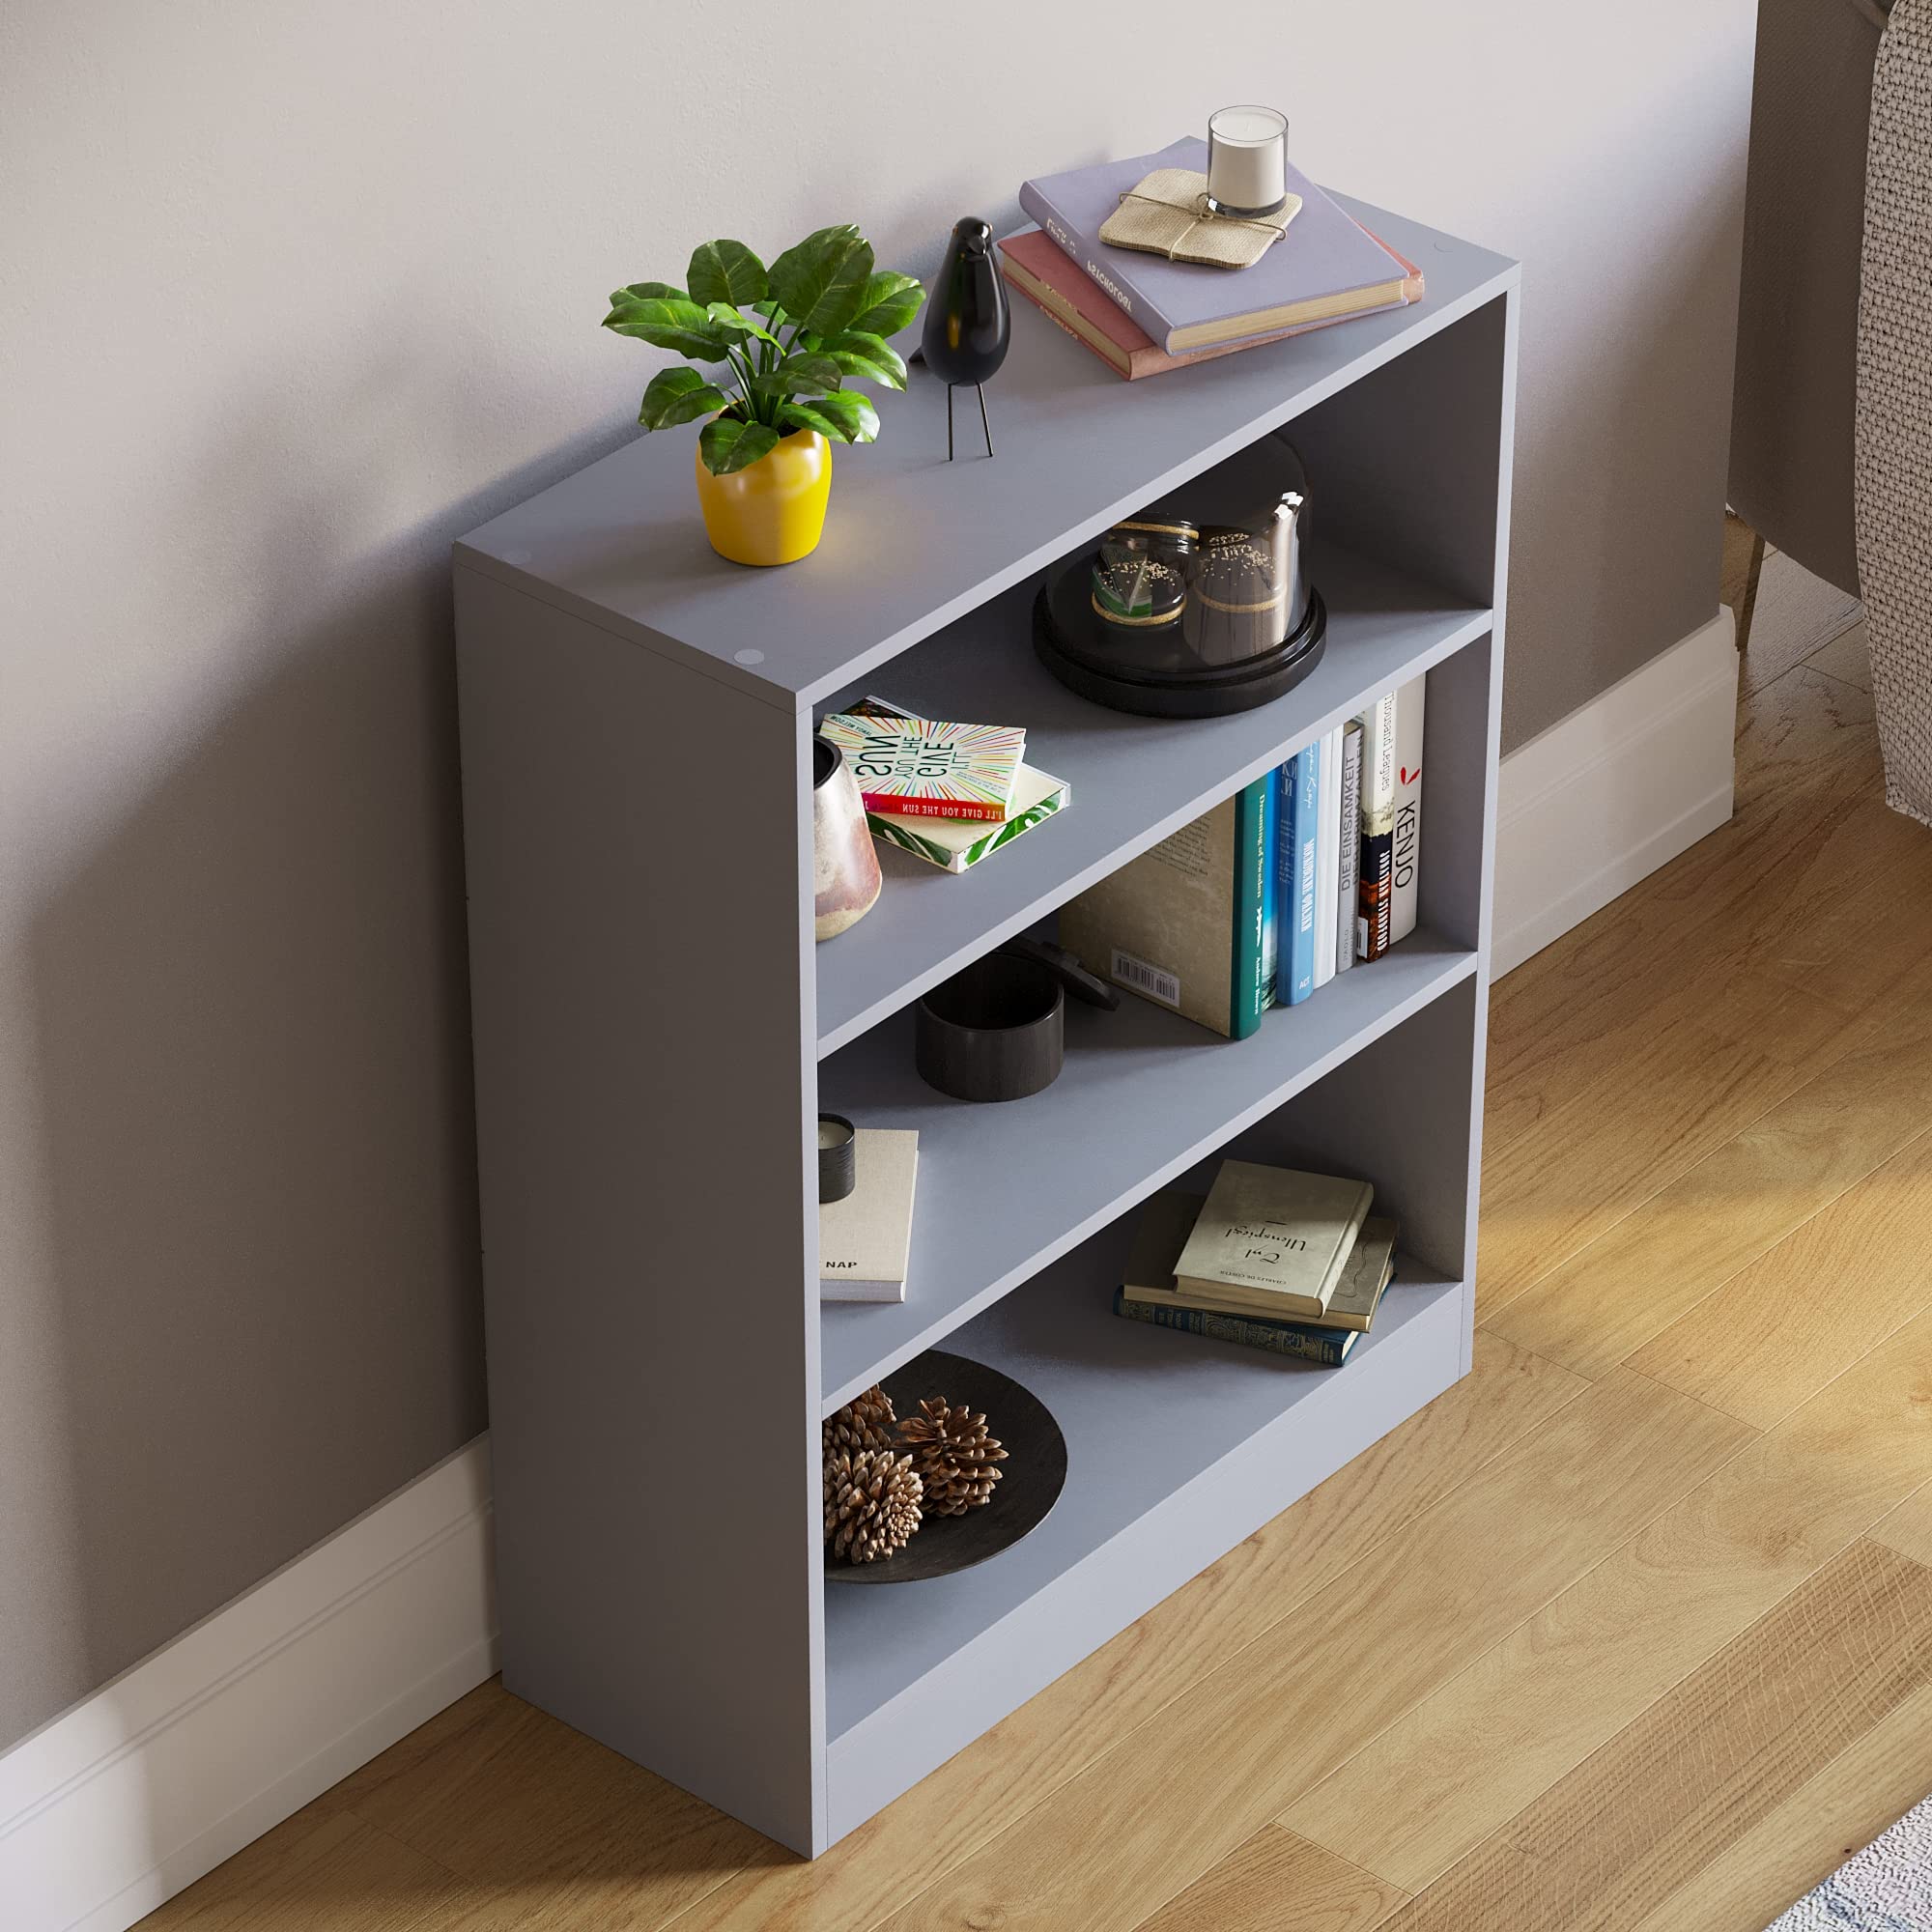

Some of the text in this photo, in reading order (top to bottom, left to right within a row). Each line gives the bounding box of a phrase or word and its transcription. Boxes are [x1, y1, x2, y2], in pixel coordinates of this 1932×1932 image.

[1380, 745, 1392, 791] Leagues
[1257, 794, 1265, 846] Dreaming
[1342, 756, 1354, 891] DIE EINSAMKEIT
[1395, 800, 1416, 888] KENJO
